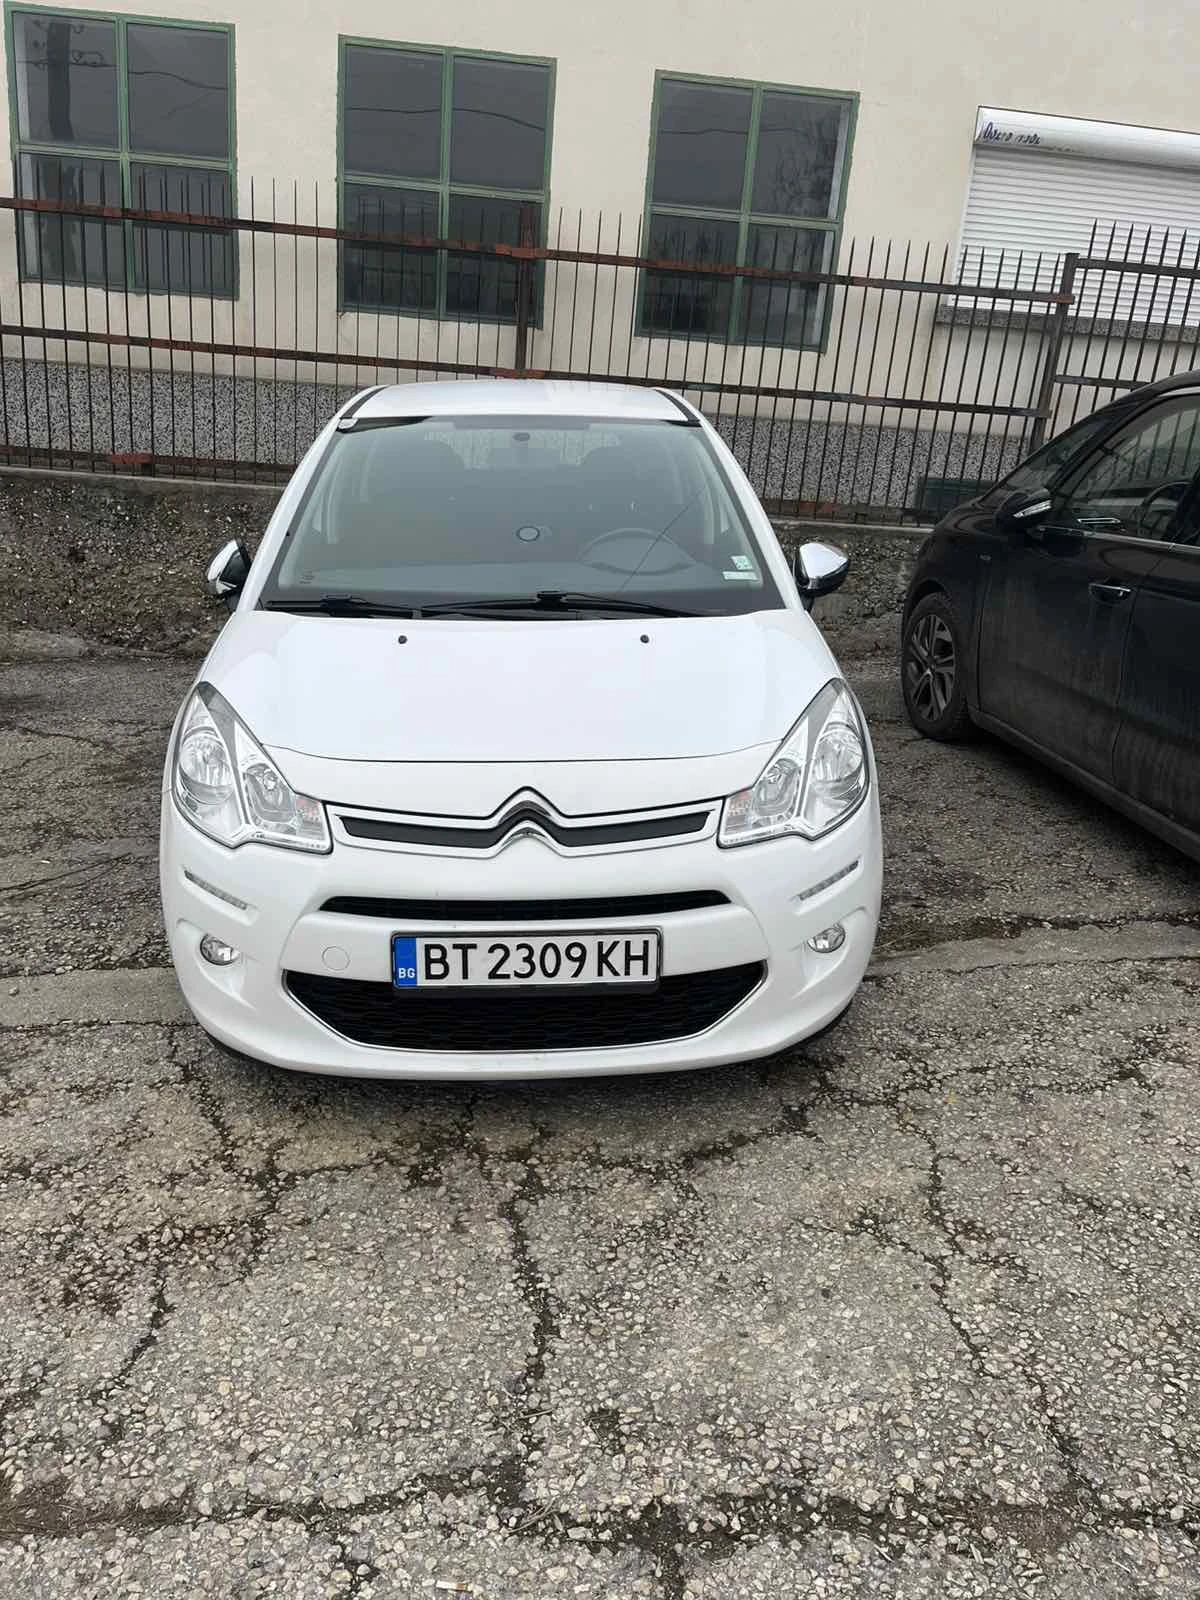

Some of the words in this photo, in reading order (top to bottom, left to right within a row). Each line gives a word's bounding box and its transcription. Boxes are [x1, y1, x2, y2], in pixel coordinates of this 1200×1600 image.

[424, 943, 478, 980] BT
[487, 941, 588, 980] 2309
[597, 939, 649, 977] KH
[398, 967, 416, 979] BG
